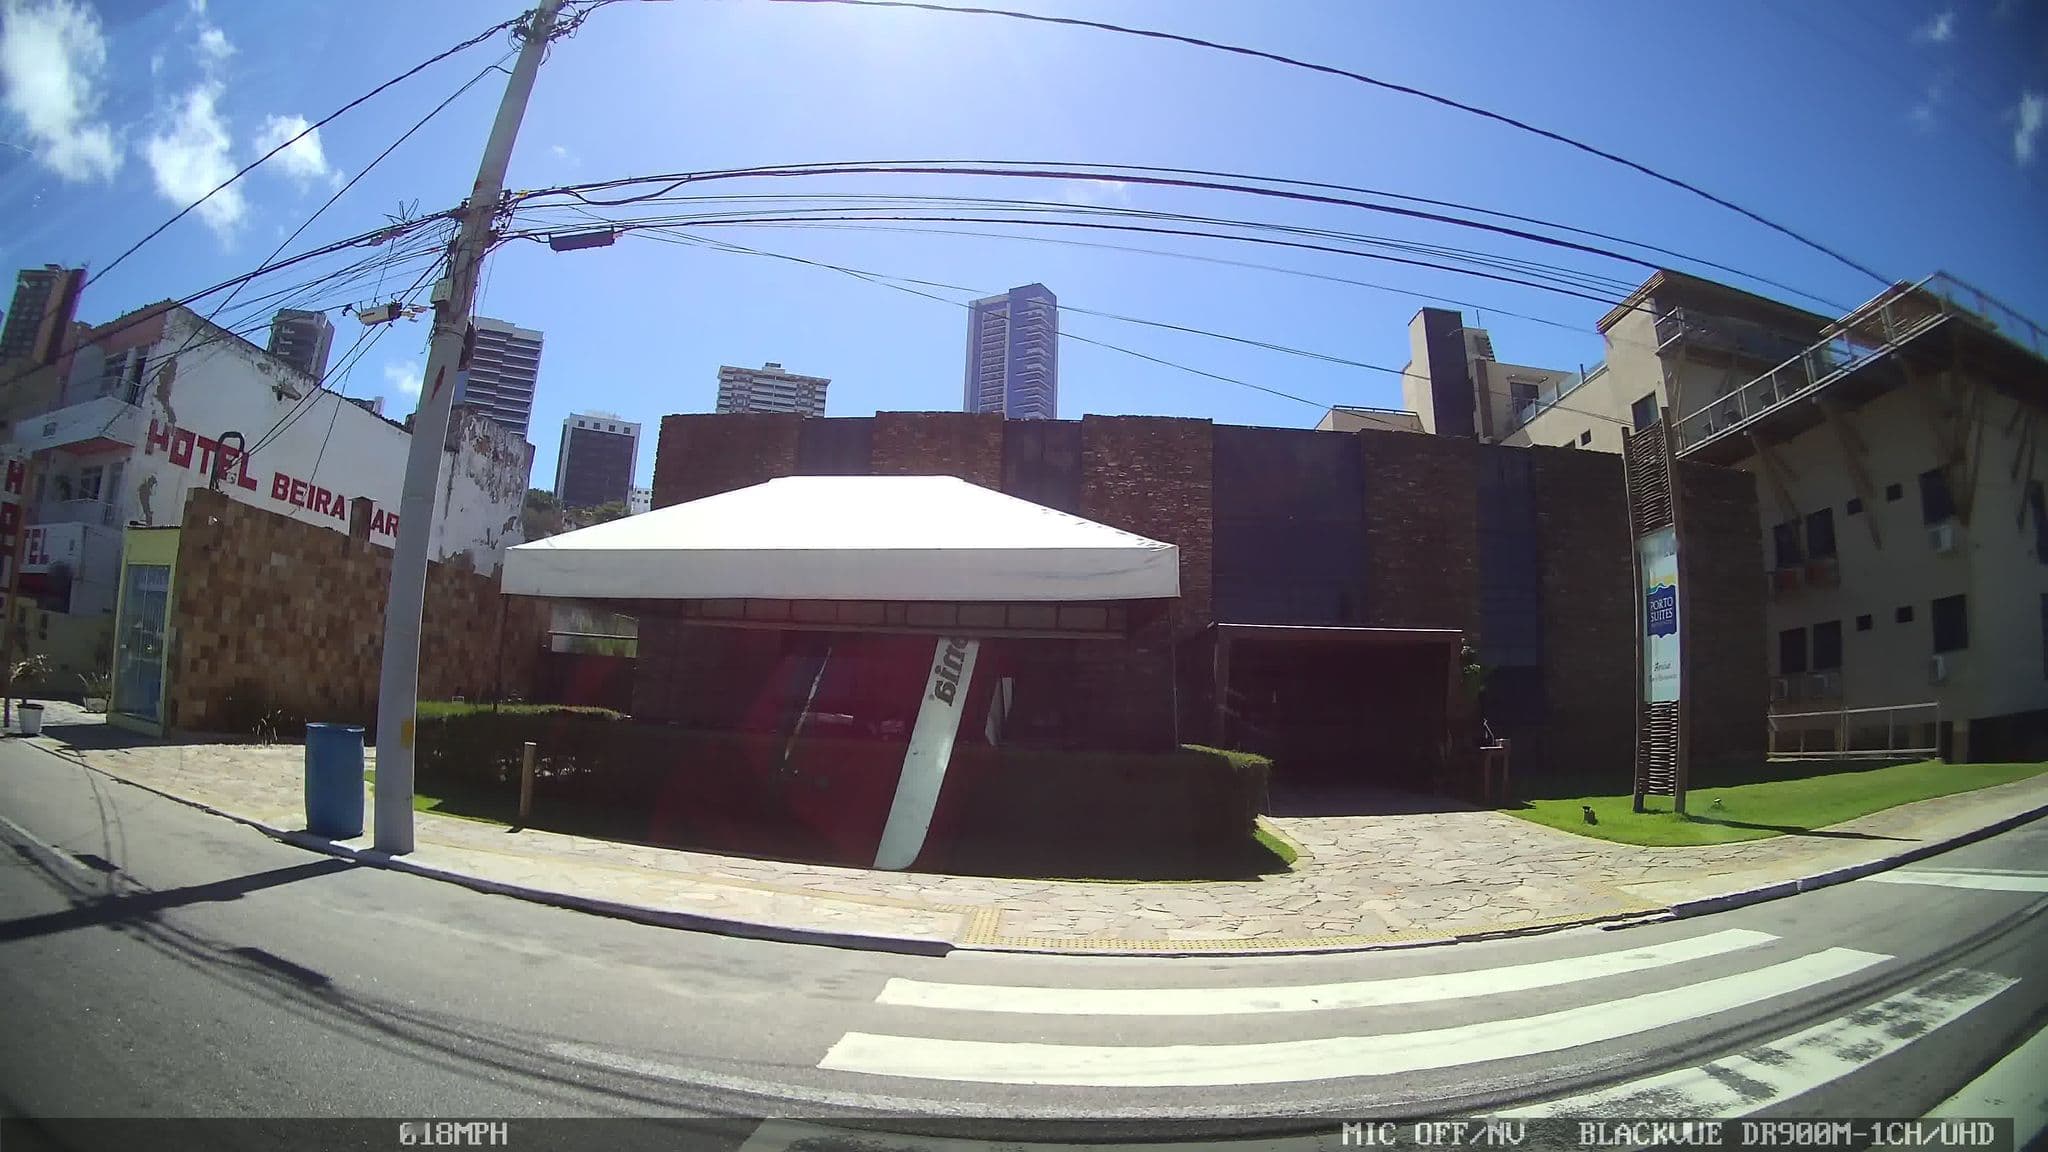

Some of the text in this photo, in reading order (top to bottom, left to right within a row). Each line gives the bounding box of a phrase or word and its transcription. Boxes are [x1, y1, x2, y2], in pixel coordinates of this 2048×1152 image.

[145, 419, 400, 538] HOTEL BEIRA AR
[1651, 597, 1673, 610] PORTO
[1651, 608, 1673, 622] SUITES
